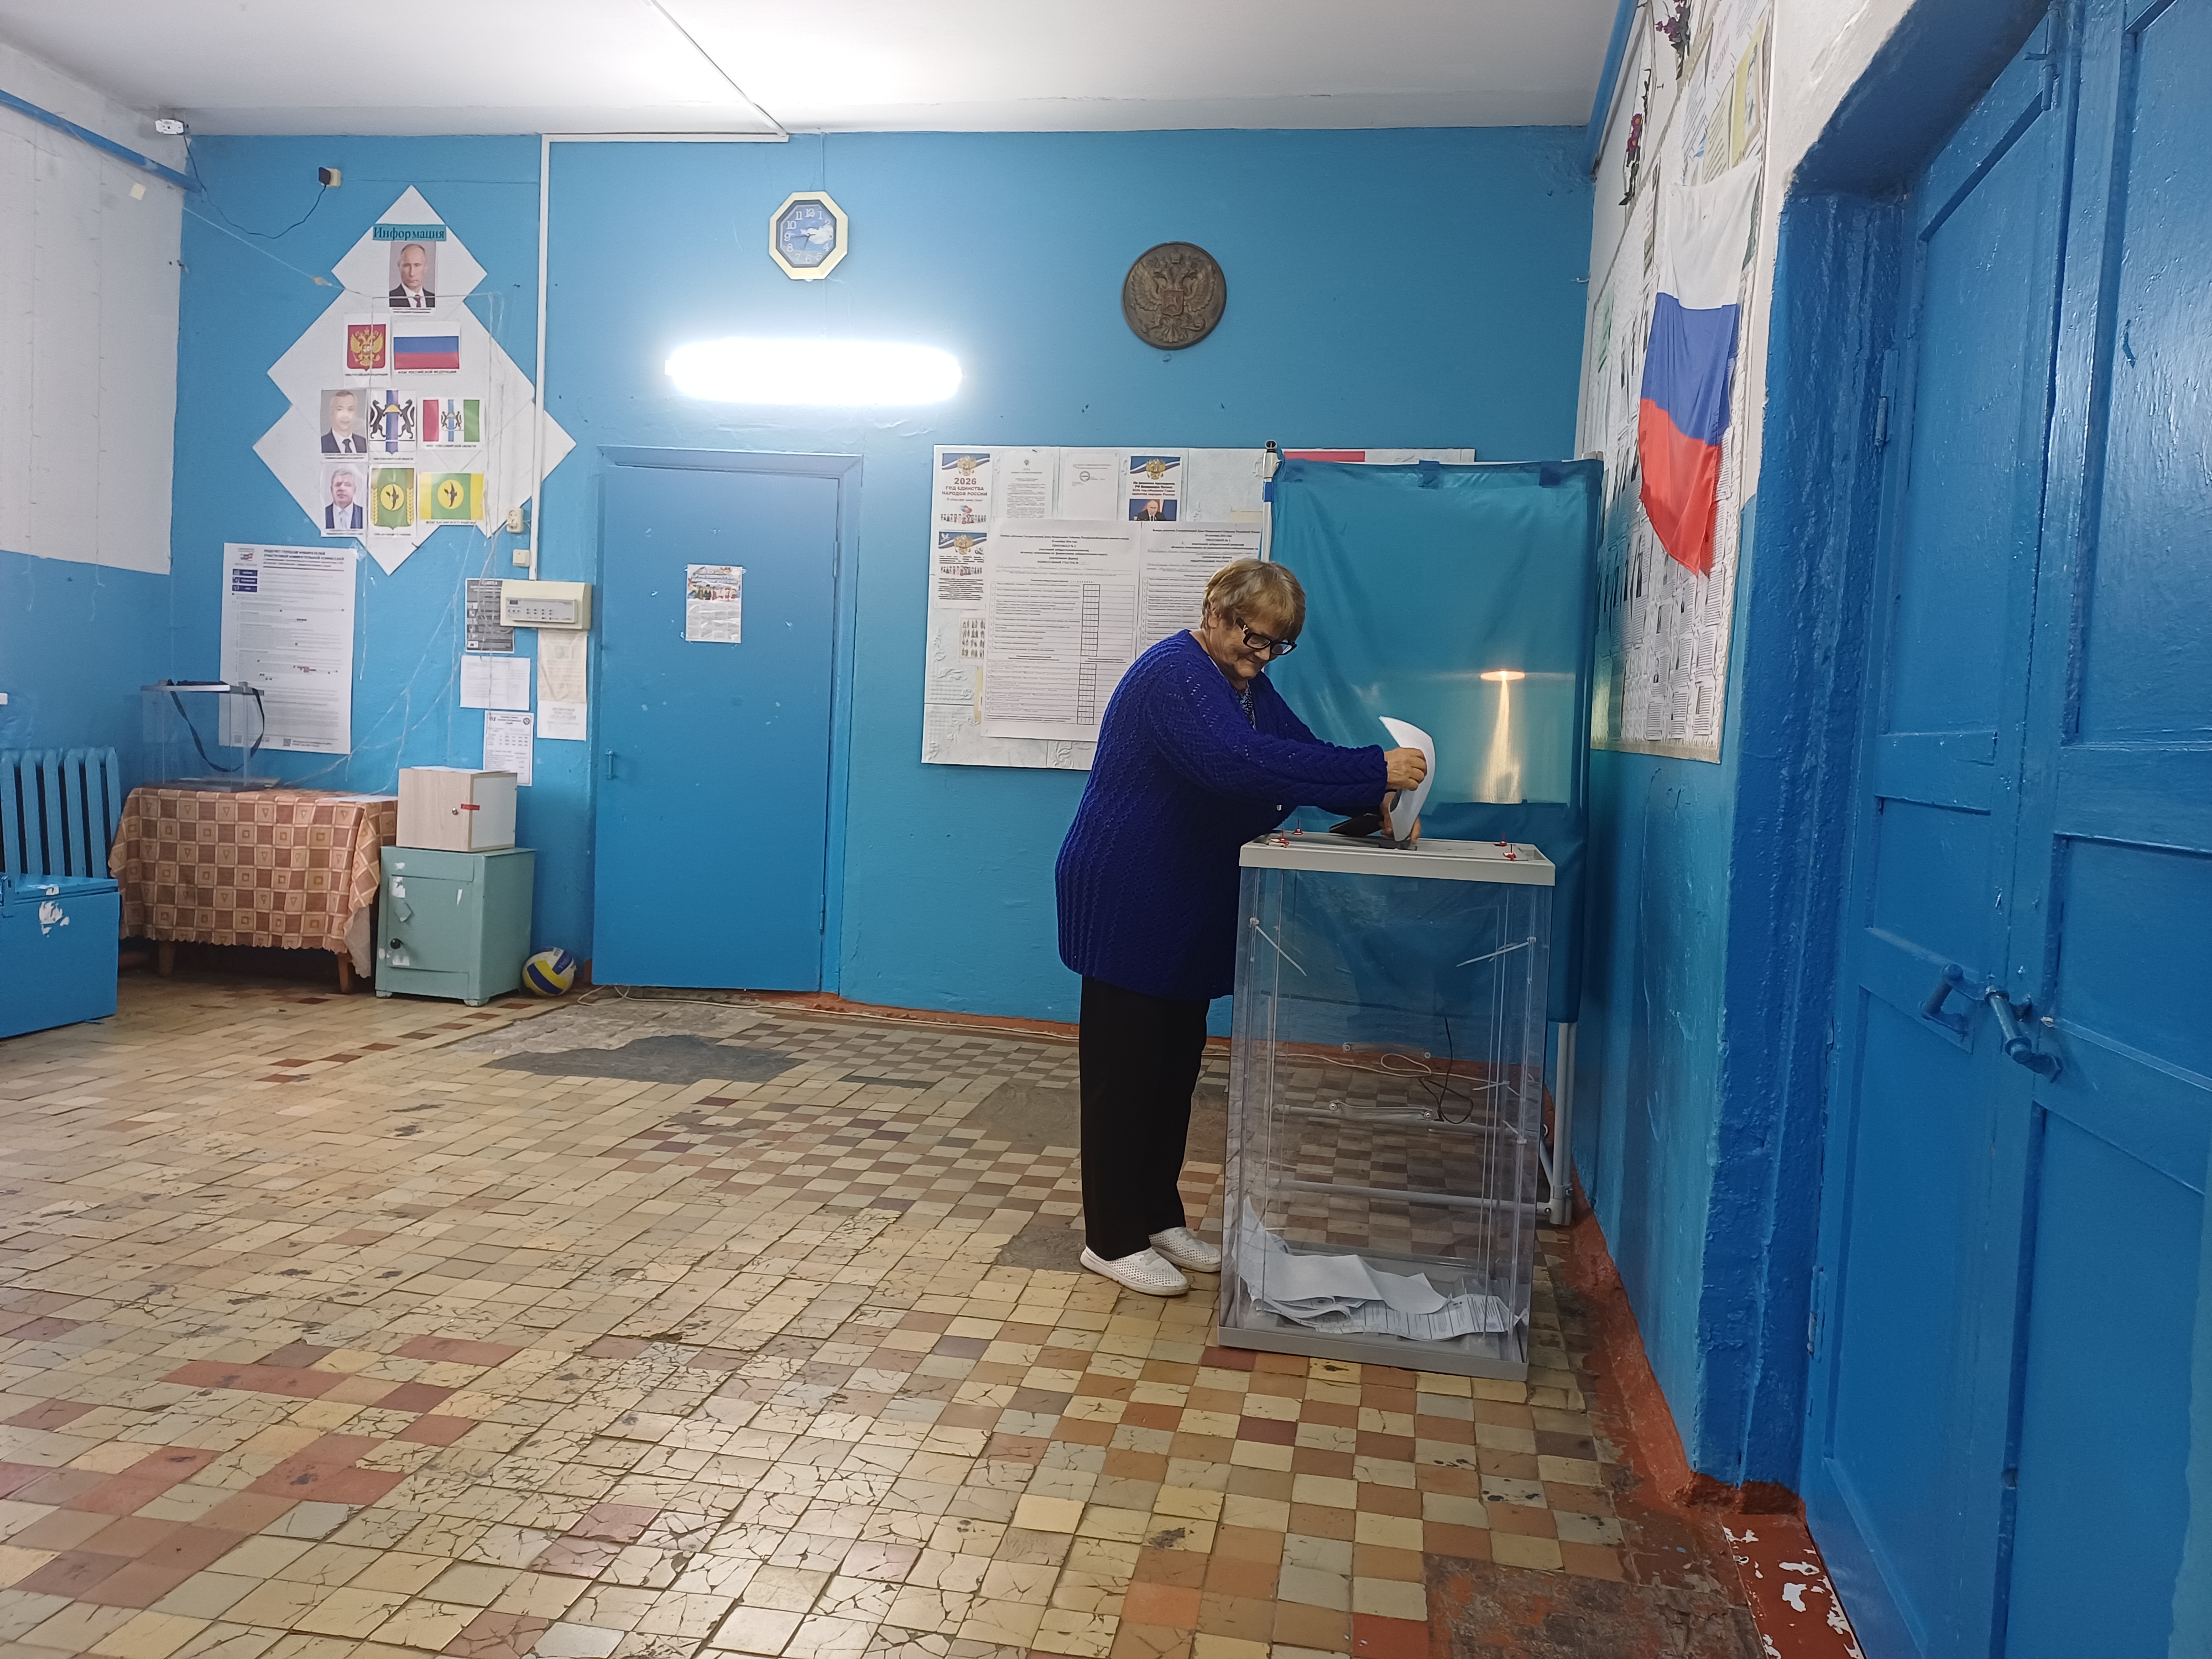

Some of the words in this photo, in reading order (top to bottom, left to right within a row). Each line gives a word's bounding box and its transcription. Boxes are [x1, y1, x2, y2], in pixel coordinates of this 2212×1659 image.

[795, 211, 803, 220] 11
[805, 208, 816, 217] 12
[818, 211, 823, 220] 1
[785, 220, 796, 229] 10
[374, 227, 444, 241] Информация
[784, 232, 790, 241] 9
[786, 243, 794, 252] 8
[823, 242, 830, 252] 4
[795, 253, 801, 261] 7
[805, 254, 811, 263] 6
[816, 252, 823, 261] 5
